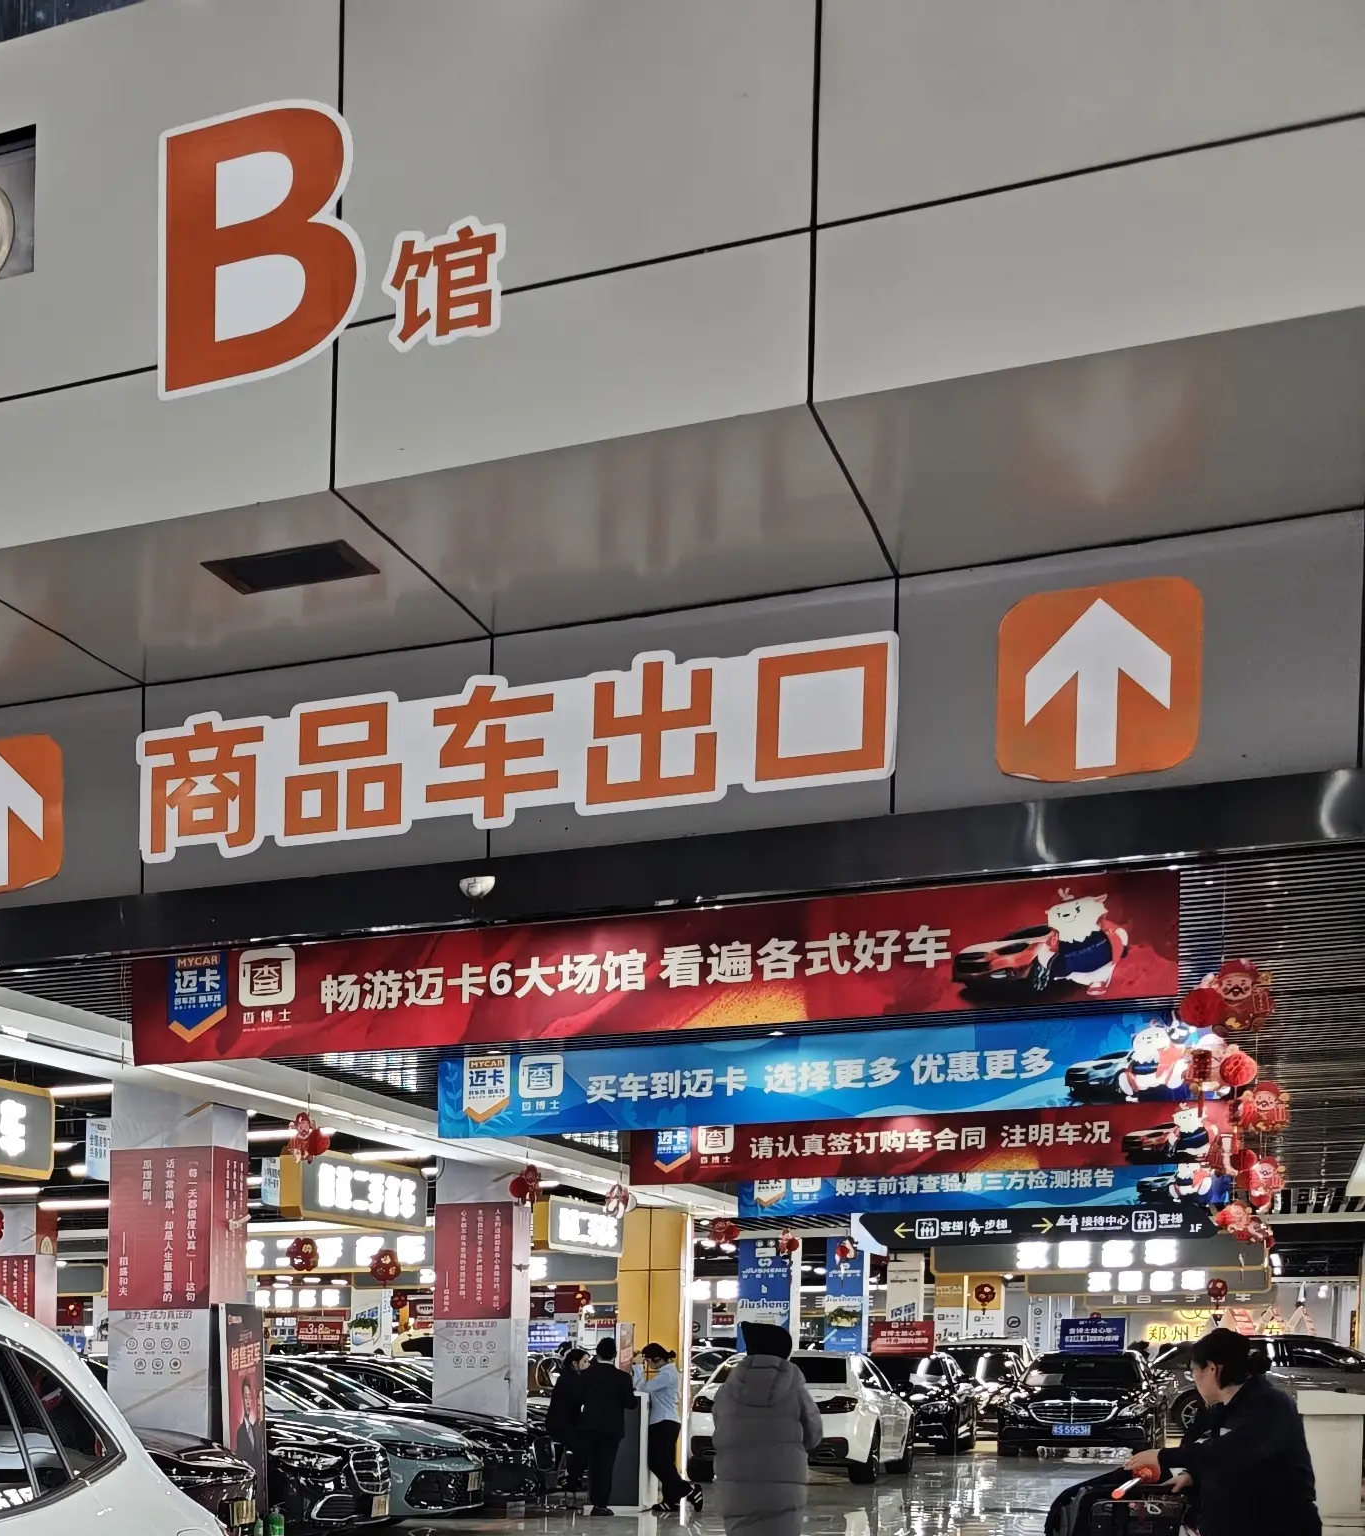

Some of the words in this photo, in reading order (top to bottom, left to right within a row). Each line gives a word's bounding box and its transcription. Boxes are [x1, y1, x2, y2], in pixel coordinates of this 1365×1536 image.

[162, 103, 499, 396] B馆
[141, 636, 894, 858] 商品车出口
[177, 955, 219, 968] MYCAR
[320, 946, 647, 1014] 畅游迈卡6大场馆
[660, 925, 953, 989] 看遍各式好车
[174, 968, 221, 994] 迈卡
[242, 1008, 292, 1025] 查博士
[470, 1060, 504, 1069] MYCAR
[586, 1065, 748, 1105] 买车到迈卡
[763, 1058, 902, 1094] 选择更多
[910, 1047, 1055, 1083] 优惠更多
[468, 1068, 505, 1088] 迈卡
[657, 1131, 688, 1146] 迈卡
[749, 1124, 987, 1160] 请认真签订购车合同
[1000, 1119, 1112, 1152] 注明车况
[834, 1168, 1115, 1198] 购车前请查验第三方检测报告
[940, 1220, 964, 1232] 客梯
[984, 1219, 1009, 1232] 步梯
[1081, 1215, 1130, 1228] 接待中心
[1158, 1213, 1184, 1225] 客梯
[1189, 1223, 1202, 1233] 1F
[738, 1298, 789, 1310] Jiusheng
